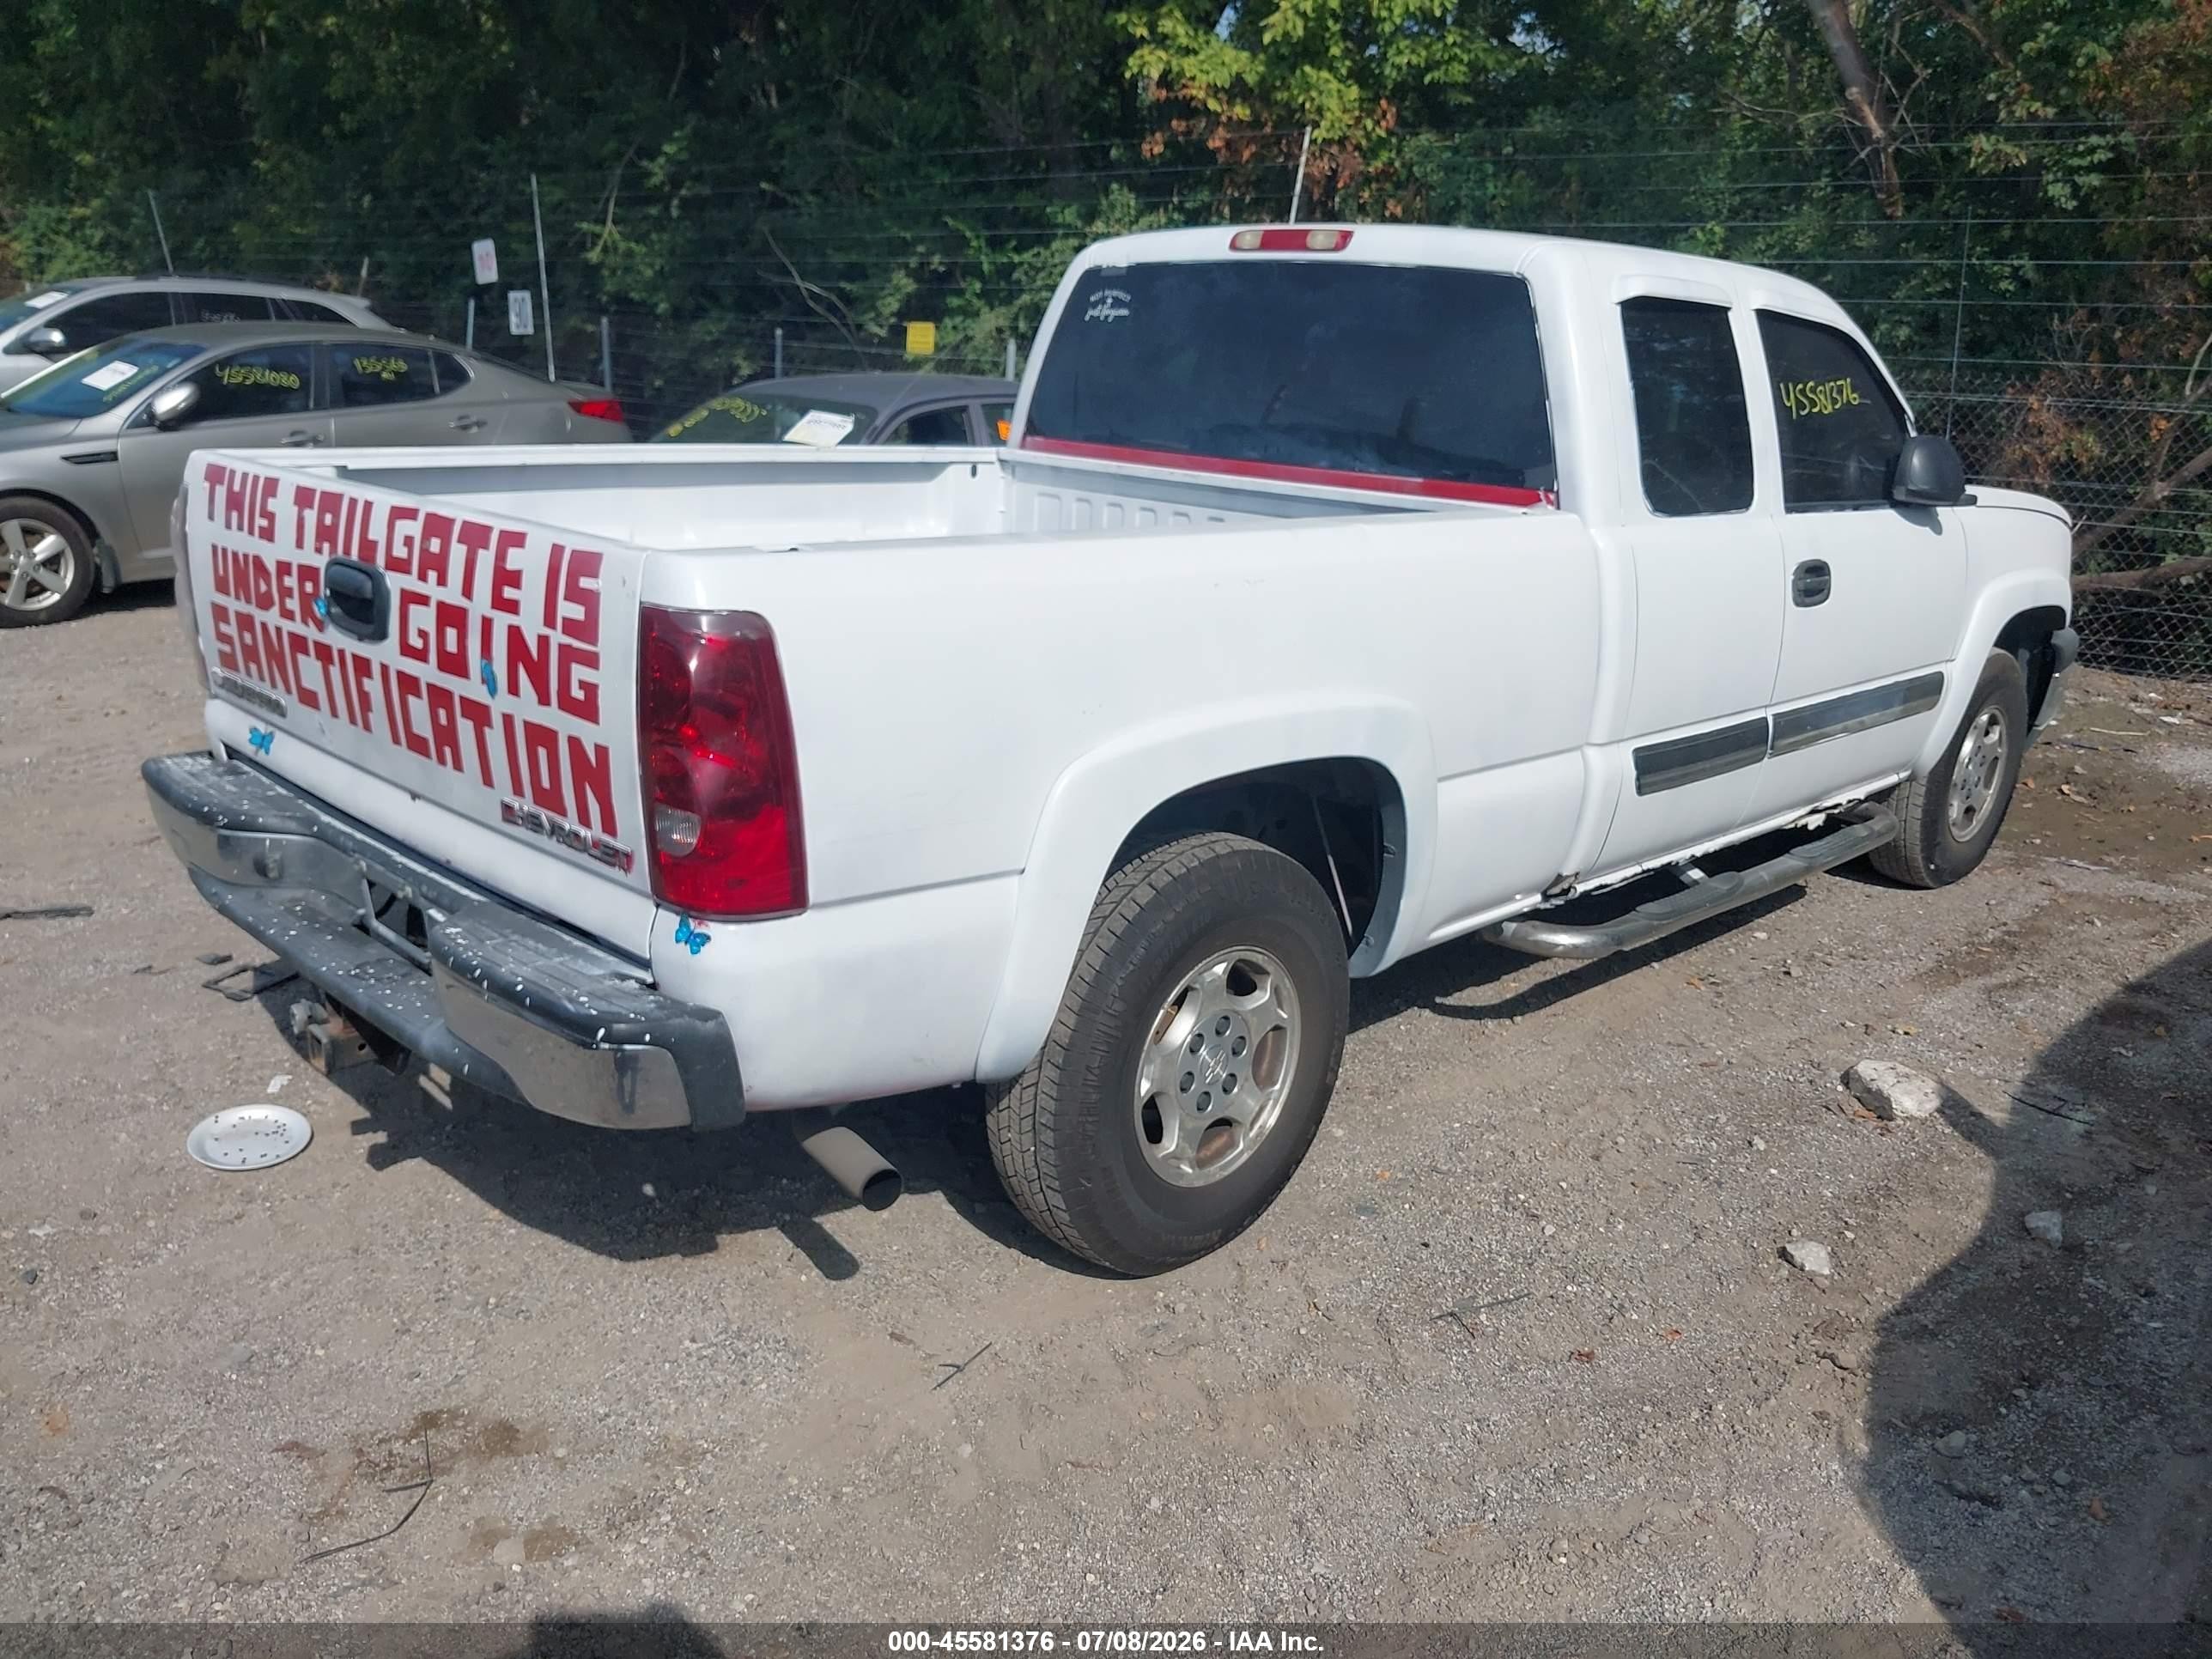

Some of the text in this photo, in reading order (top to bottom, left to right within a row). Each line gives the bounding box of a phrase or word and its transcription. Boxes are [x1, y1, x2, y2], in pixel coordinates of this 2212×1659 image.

[1779, 378, 1862, 420] 45581376
[204, 464, 604, 647] THIS TAILGATE IS
[211, 544, 326, 634] UNDER
[398, 587, 601, 726] GOING
[211, 600, 618, 838] SANCTIFICATION
